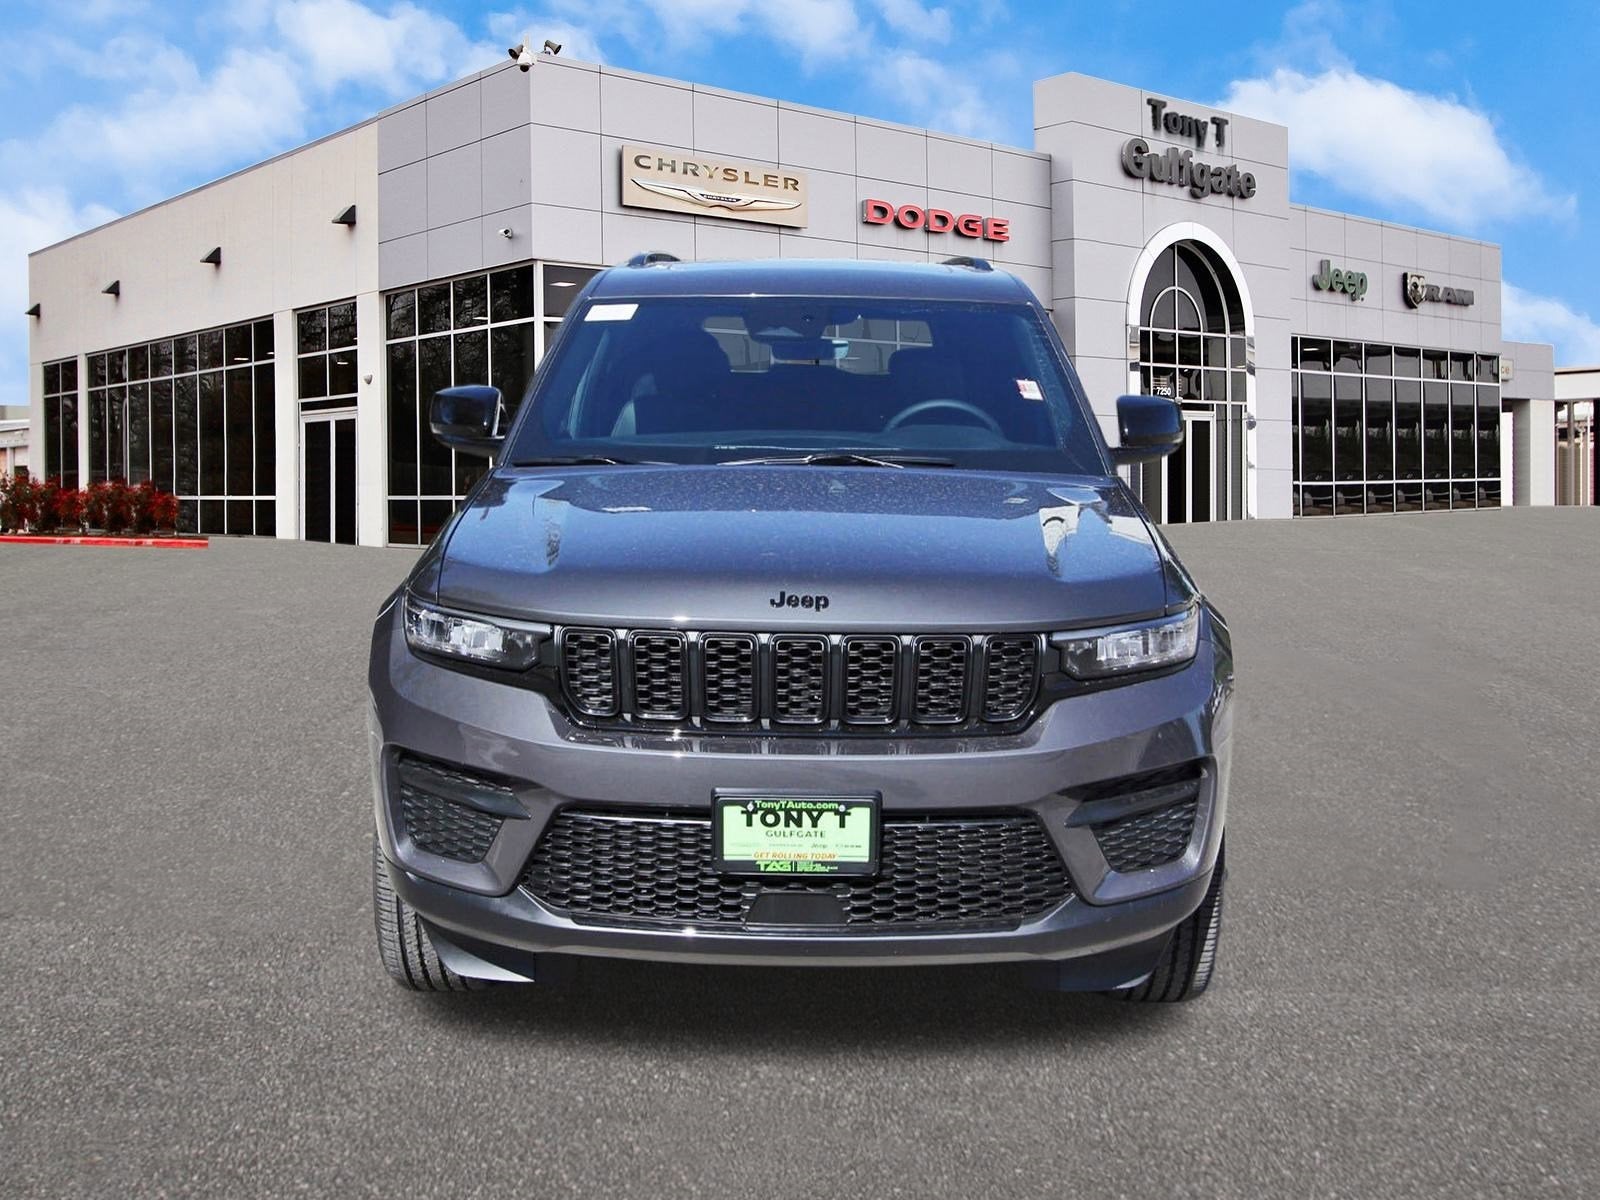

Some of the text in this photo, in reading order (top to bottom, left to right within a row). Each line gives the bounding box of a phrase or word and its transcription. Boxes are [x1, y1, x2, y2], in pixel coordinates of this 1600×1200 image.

[1147, 98, 1229, 148] Tony T
[633, 153, 800, 192] CHRYSLER
[1121, 138, 1257, 199] Gulfgate
[862, 198, 1010, 242] DODGE
[1312, 259, 1368, 301] Jeep
[1424, 283, 1475, 307] RAM
[769, 591, 830, 612] Jeep
[755, 800, 839, 810] TonyTAuto.com
[741, 809, 851, 828] TONY T
[765, 830, 826, 838] GULFGATE
[754, 851, 838, 860] GET ROLLING TODAY
[756, 860, 792, 872] TAG
